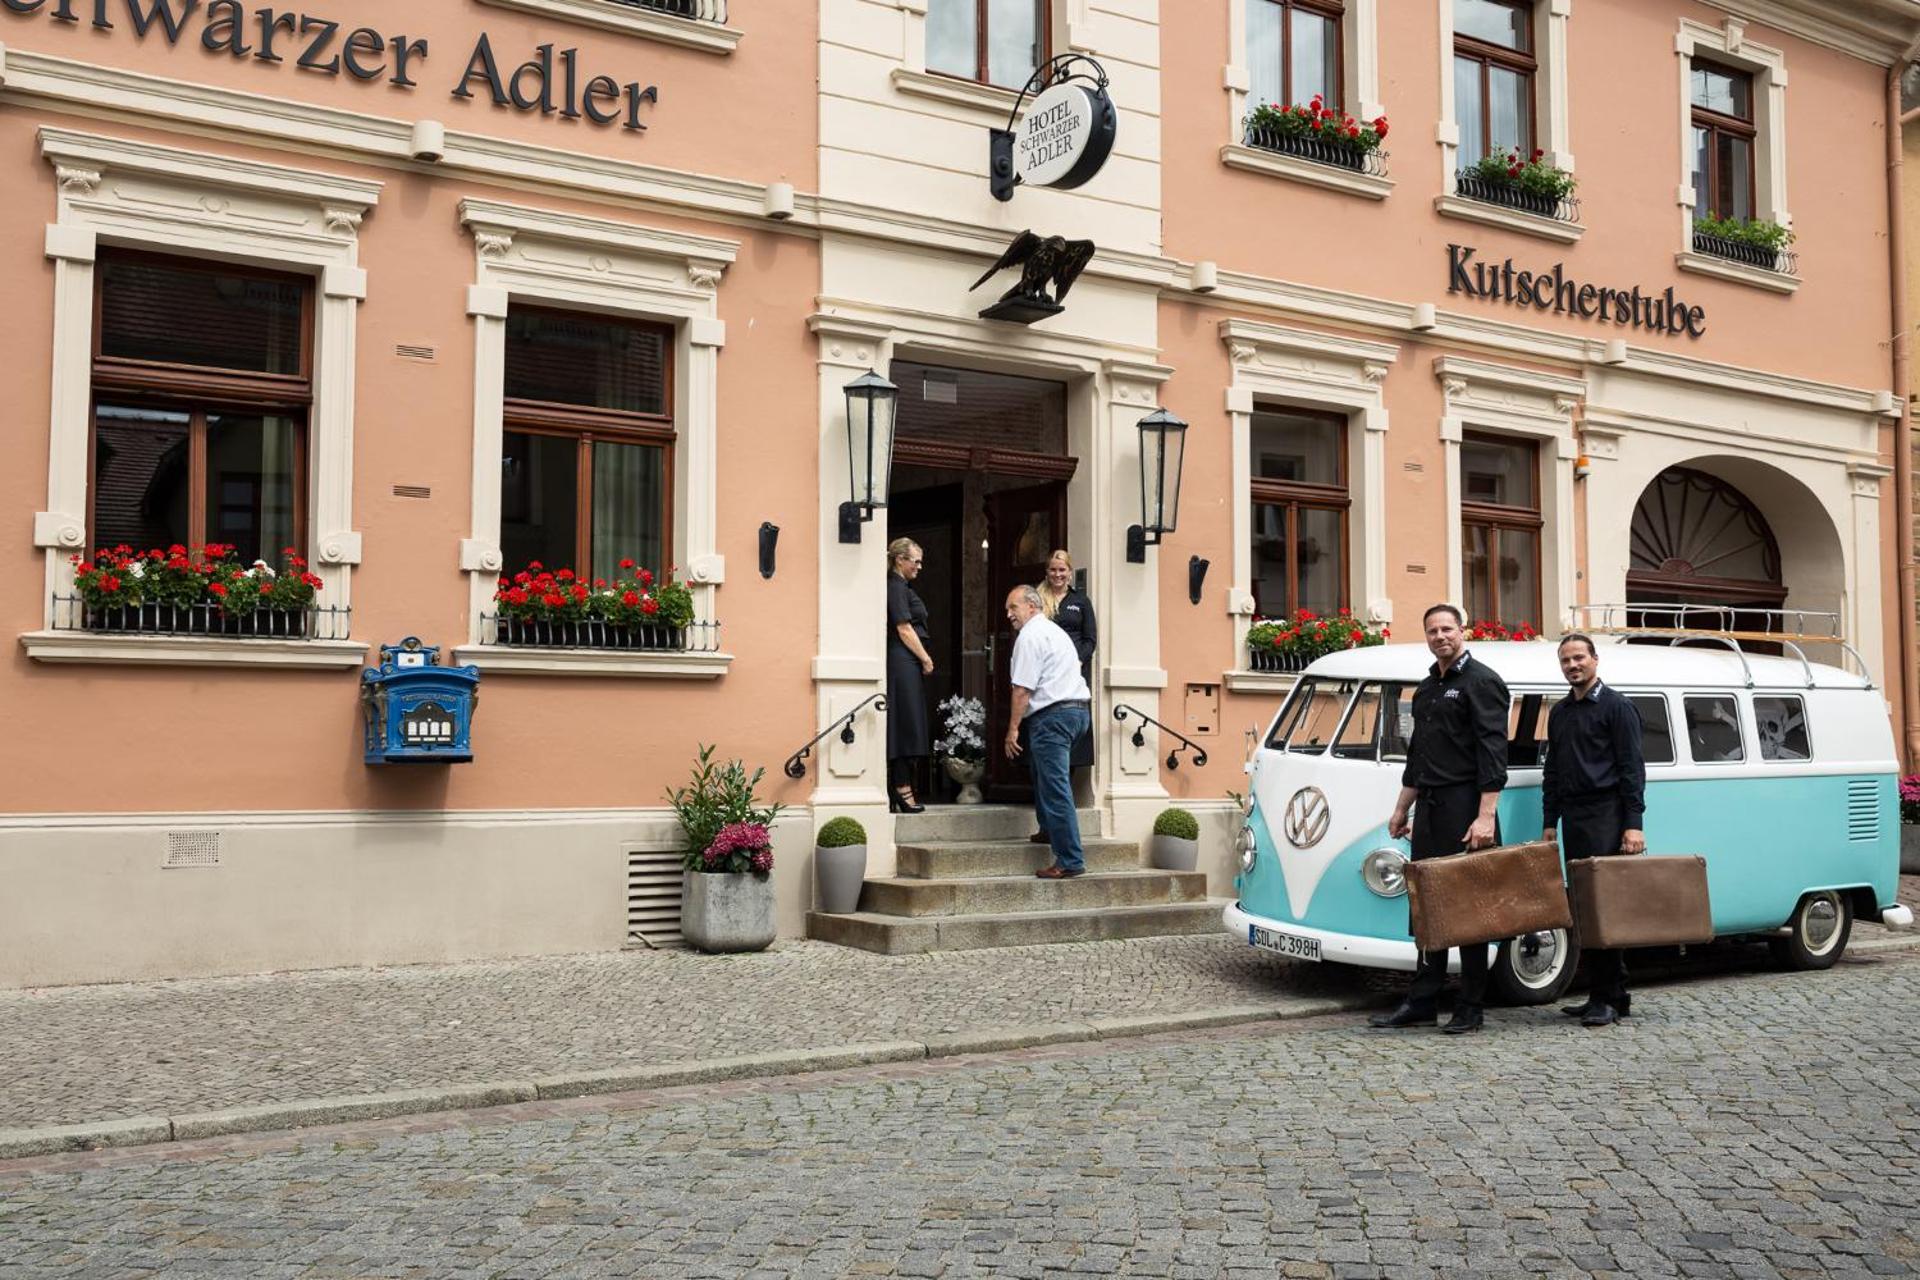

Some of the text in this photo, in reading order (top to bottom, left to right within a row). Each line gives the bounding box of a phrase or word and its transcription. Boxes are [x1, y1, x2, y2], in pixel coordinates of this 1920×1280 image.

[0, 0, 657, 131] warzer Adler
[1020, 114, 1080, 154] SCHWARZER
[1028, 100, 1072, 135] HOTEL
[1027, 134, 1073, 171] ADLER
[1446, 243, 1706, 338] Kutscherstube
[1285, 786, 1330, 849] VW
[1255, 928, 1319, 958] SDL C 398H
